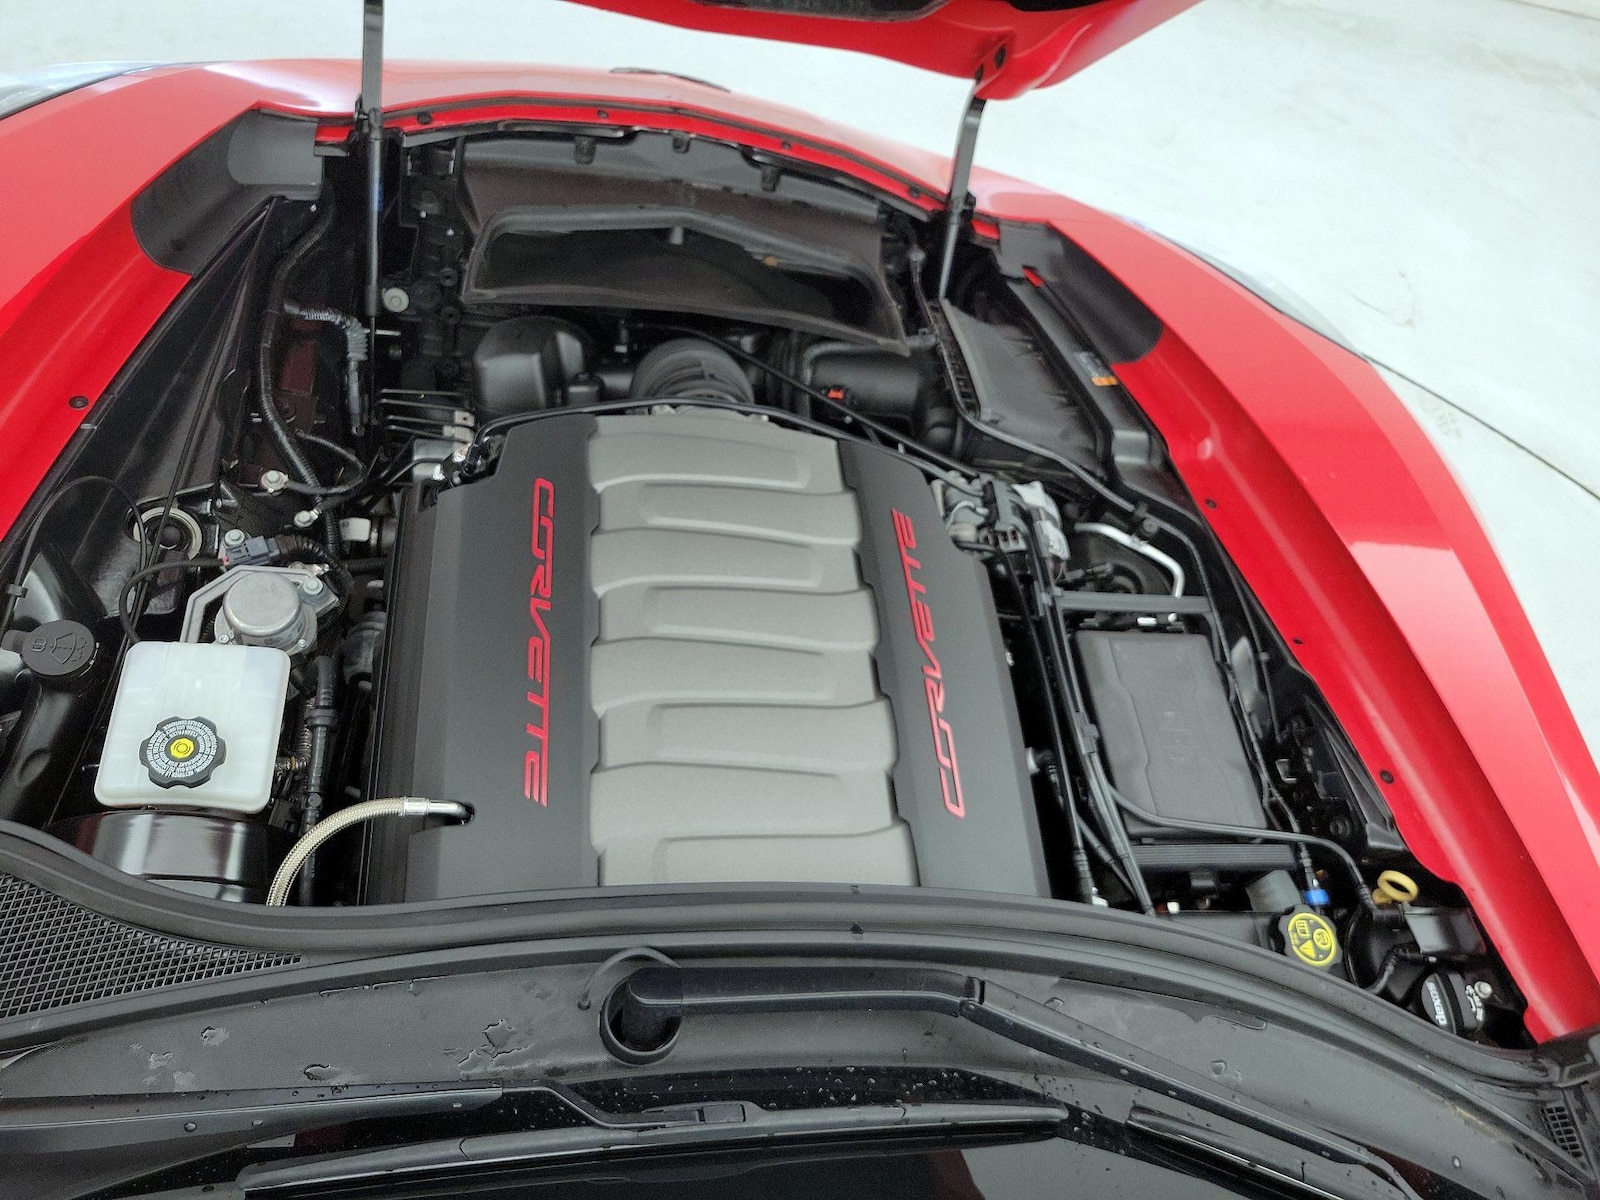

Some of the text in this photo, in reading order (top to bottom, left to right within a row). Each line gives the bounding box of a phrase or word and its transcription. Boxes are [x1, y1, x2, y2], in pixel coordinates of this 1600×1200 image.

[524, 477, 555, 807] CORVETTE
[891, 508, 965, 819] CORVETTE
[1425, 981, 1447, 1025] dexos
